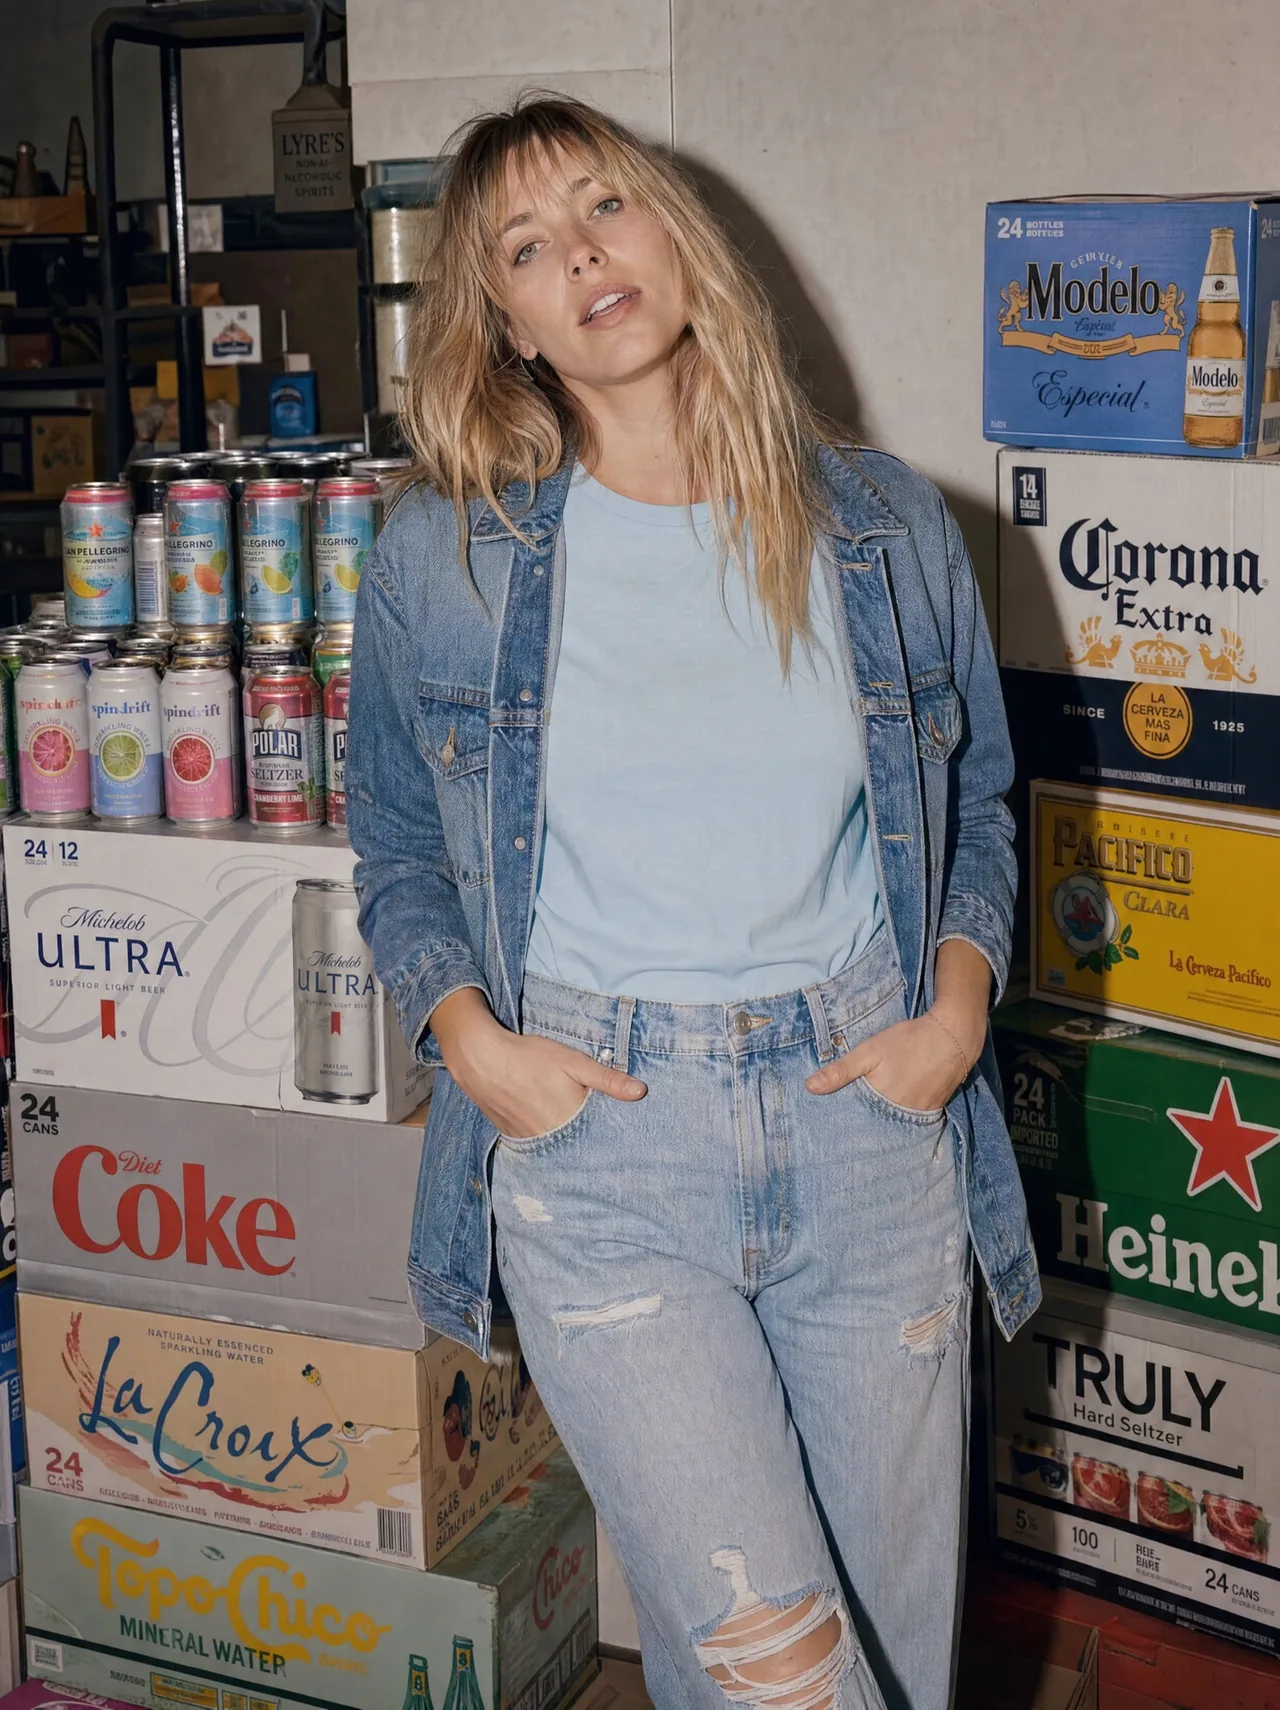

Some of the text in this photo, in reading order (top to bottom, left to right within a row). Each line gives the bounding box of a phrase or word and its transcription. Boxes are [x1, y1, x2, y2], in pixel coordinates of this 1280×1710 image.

[282, 132, 344, 155] LYRE'S
[295, 186, 334, 197] SPIRITS
[997, 217, 1064, 238] 24 BOTTLES
[1025, 262, 1160, 321] Modelo
[1192, 365, 1238, 388] Modelo
[1032, 369, 1147, 418] Especial
[1019, 473, 1038, 499] 14
[1059, 517, 1265, 601] Corona
[1114, 588, 1213, 636] Extra
[91, 701, 151, 719] spindrift
[1150, 692, 1166, 704] LA
[1062, 704, 1105, 719] SINCE
[1130, 703, 1184, 720] CERVEZA
[1144, 730, 1171, 743] FINA
[1145, 718, 1171, 731] MAS
[1212, 720, 1245, 733] 1925
[252, 731, 299, 758] POLAR
[250, 768, 304, 781] SELTZER
[287, 794, 304, 803] LIME
[24, 839, 79, 860] 24 12
[1053, 815, 1194, 884] PACIFICO
[1123, 890, 1190, 921] CLARA
[60, 906, 146, 931] Michelob
[37, 932, 184, 977] ULTRA
[308, 950, 362, 969] Michelob
[1169, 950, 1183, 972] La
[1186, 955, 1225, 980] Cerveza
[49, 979, 166, 994] SUPERIOR LIGHT BEER
[297, 969, 377, 996] ULTRA
[1013, 1072, 1045, 1110] 24
[20, 1093, 60, 1123] 24
[1013, 1107, 1046, 1128] PACK
[22, 1122, 59, 1136] CANS
[118, 1150, 163, 1175] Diet
[52, 1144, 296, 1276] Coke
[147, 1328, 274, 1355] NATURALLY ESSENCED
[160, 1342, 264, 1364] SPARKLING WATER
[1032, 1332, 1227, 1433] TRULY
[79, 1336, 339, 1483] La Croix
[1073, 1402, 1183, 1447] Hard Seltzer
[45, 1447, 83, 1478] 24
[47, 1475, 84, 1492] CANS
[1072, 1526, 1098, 1550] 100
[71, 1516, 228, 1621] Topo
[226, 1554, 393, 1664] Chico
[532, 1544, 586, 1631] Chico
[1204, 1568, 1229, 1594] 24
[1231, 1583, 1260, 1602] CANS
[119, 1614, 209, 1657] MINERAL
[212, 1638, 287, 1678] WATER
